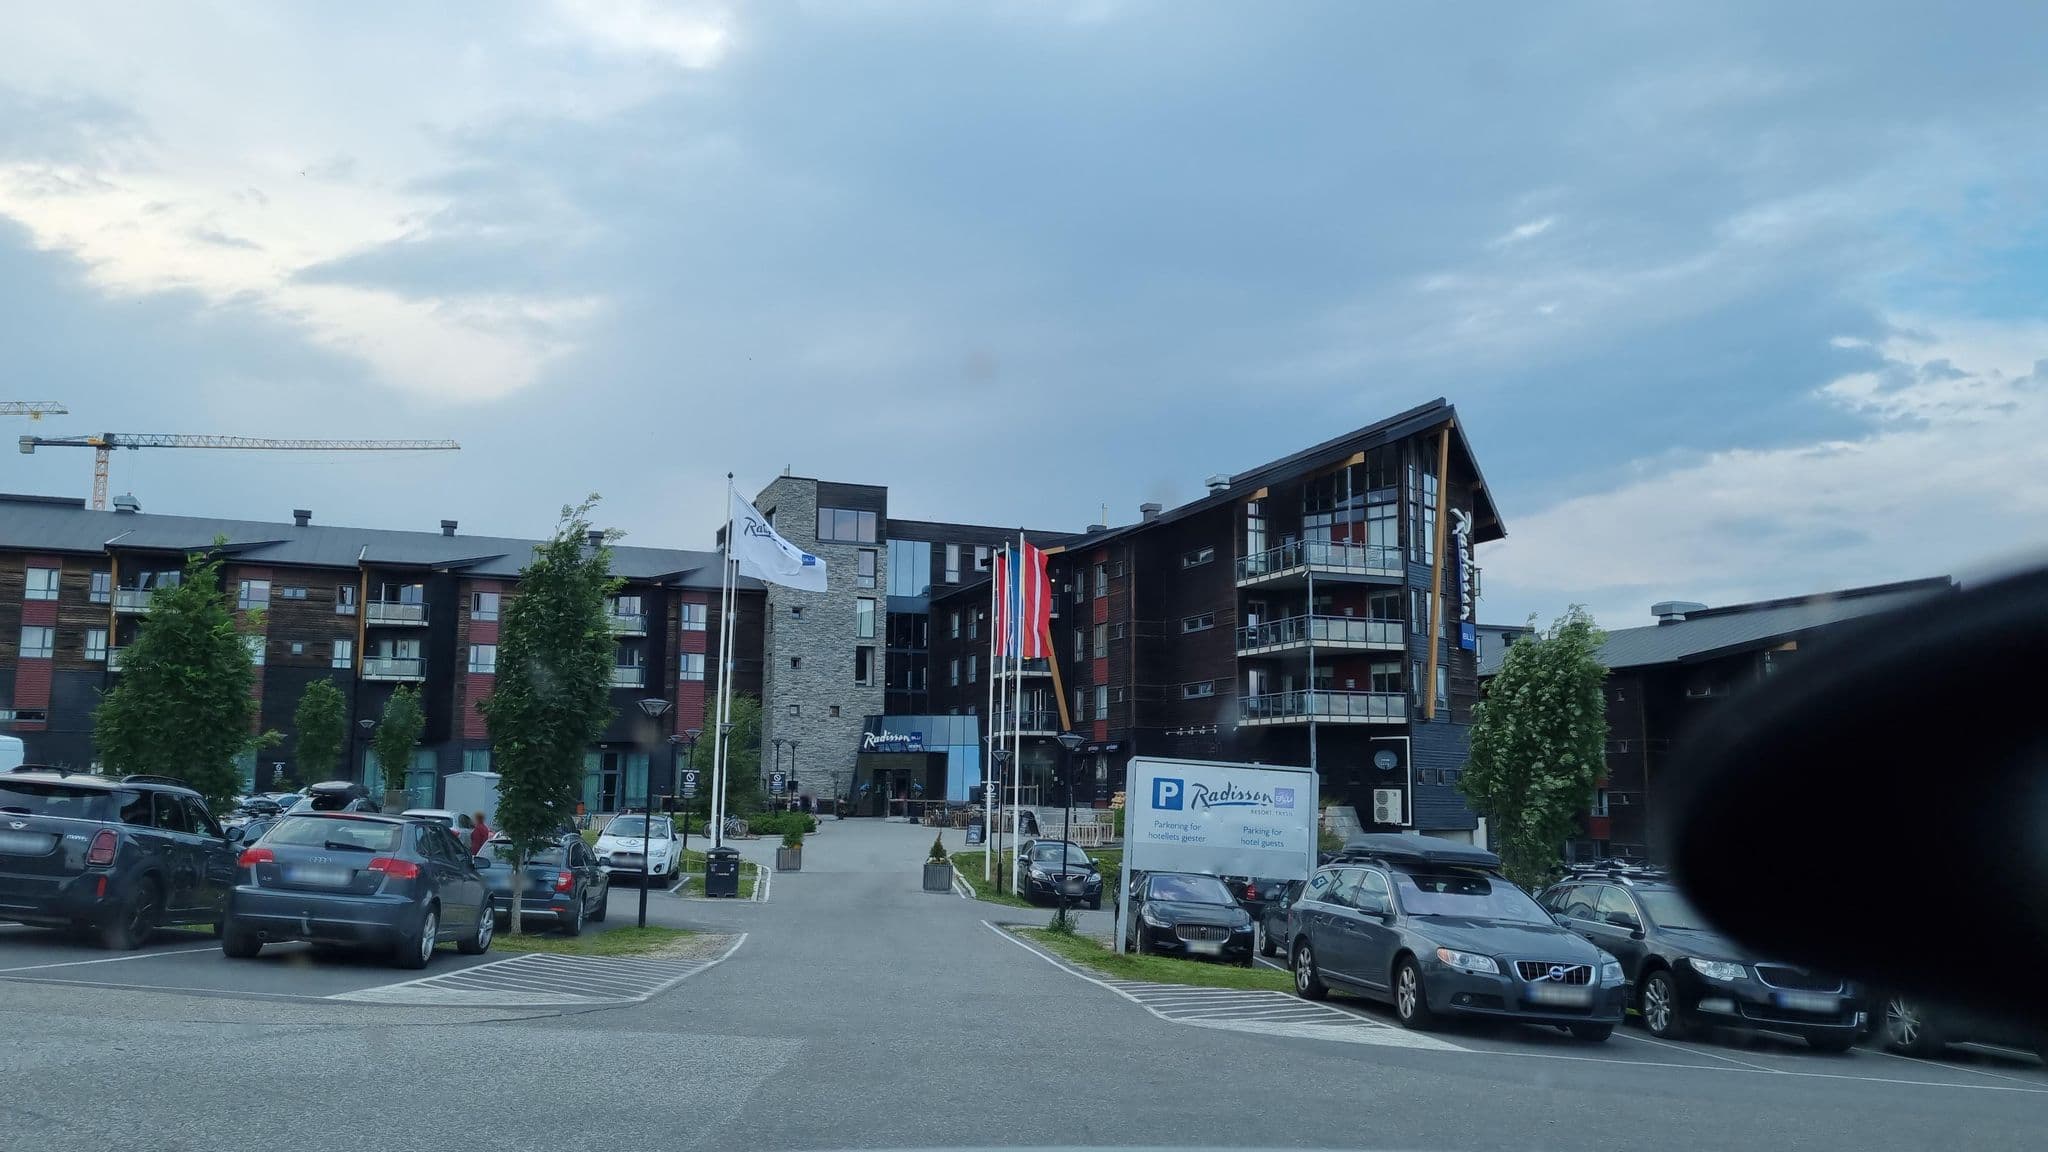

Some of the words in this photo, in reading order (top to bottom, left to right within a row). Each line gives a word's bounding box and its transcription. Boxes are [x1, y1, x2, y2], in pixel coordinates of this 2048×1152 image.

[864, 730, 910, 749] Radisson
[1159, 781, 1179, 807] P
[1191, 781, 1273, 810] Radisson
[1154, 820, 1189, 832] Parkering
[1190, 822, 1202, 832] for
[1243, 826, 1270, 837] Parking
[1271, 828, 1283, 837] for
[1148, 832, 1180, 841] hotellets
[1241, 838, 1259, 846] hotel
[1261, 840, 1285, 849] guests
